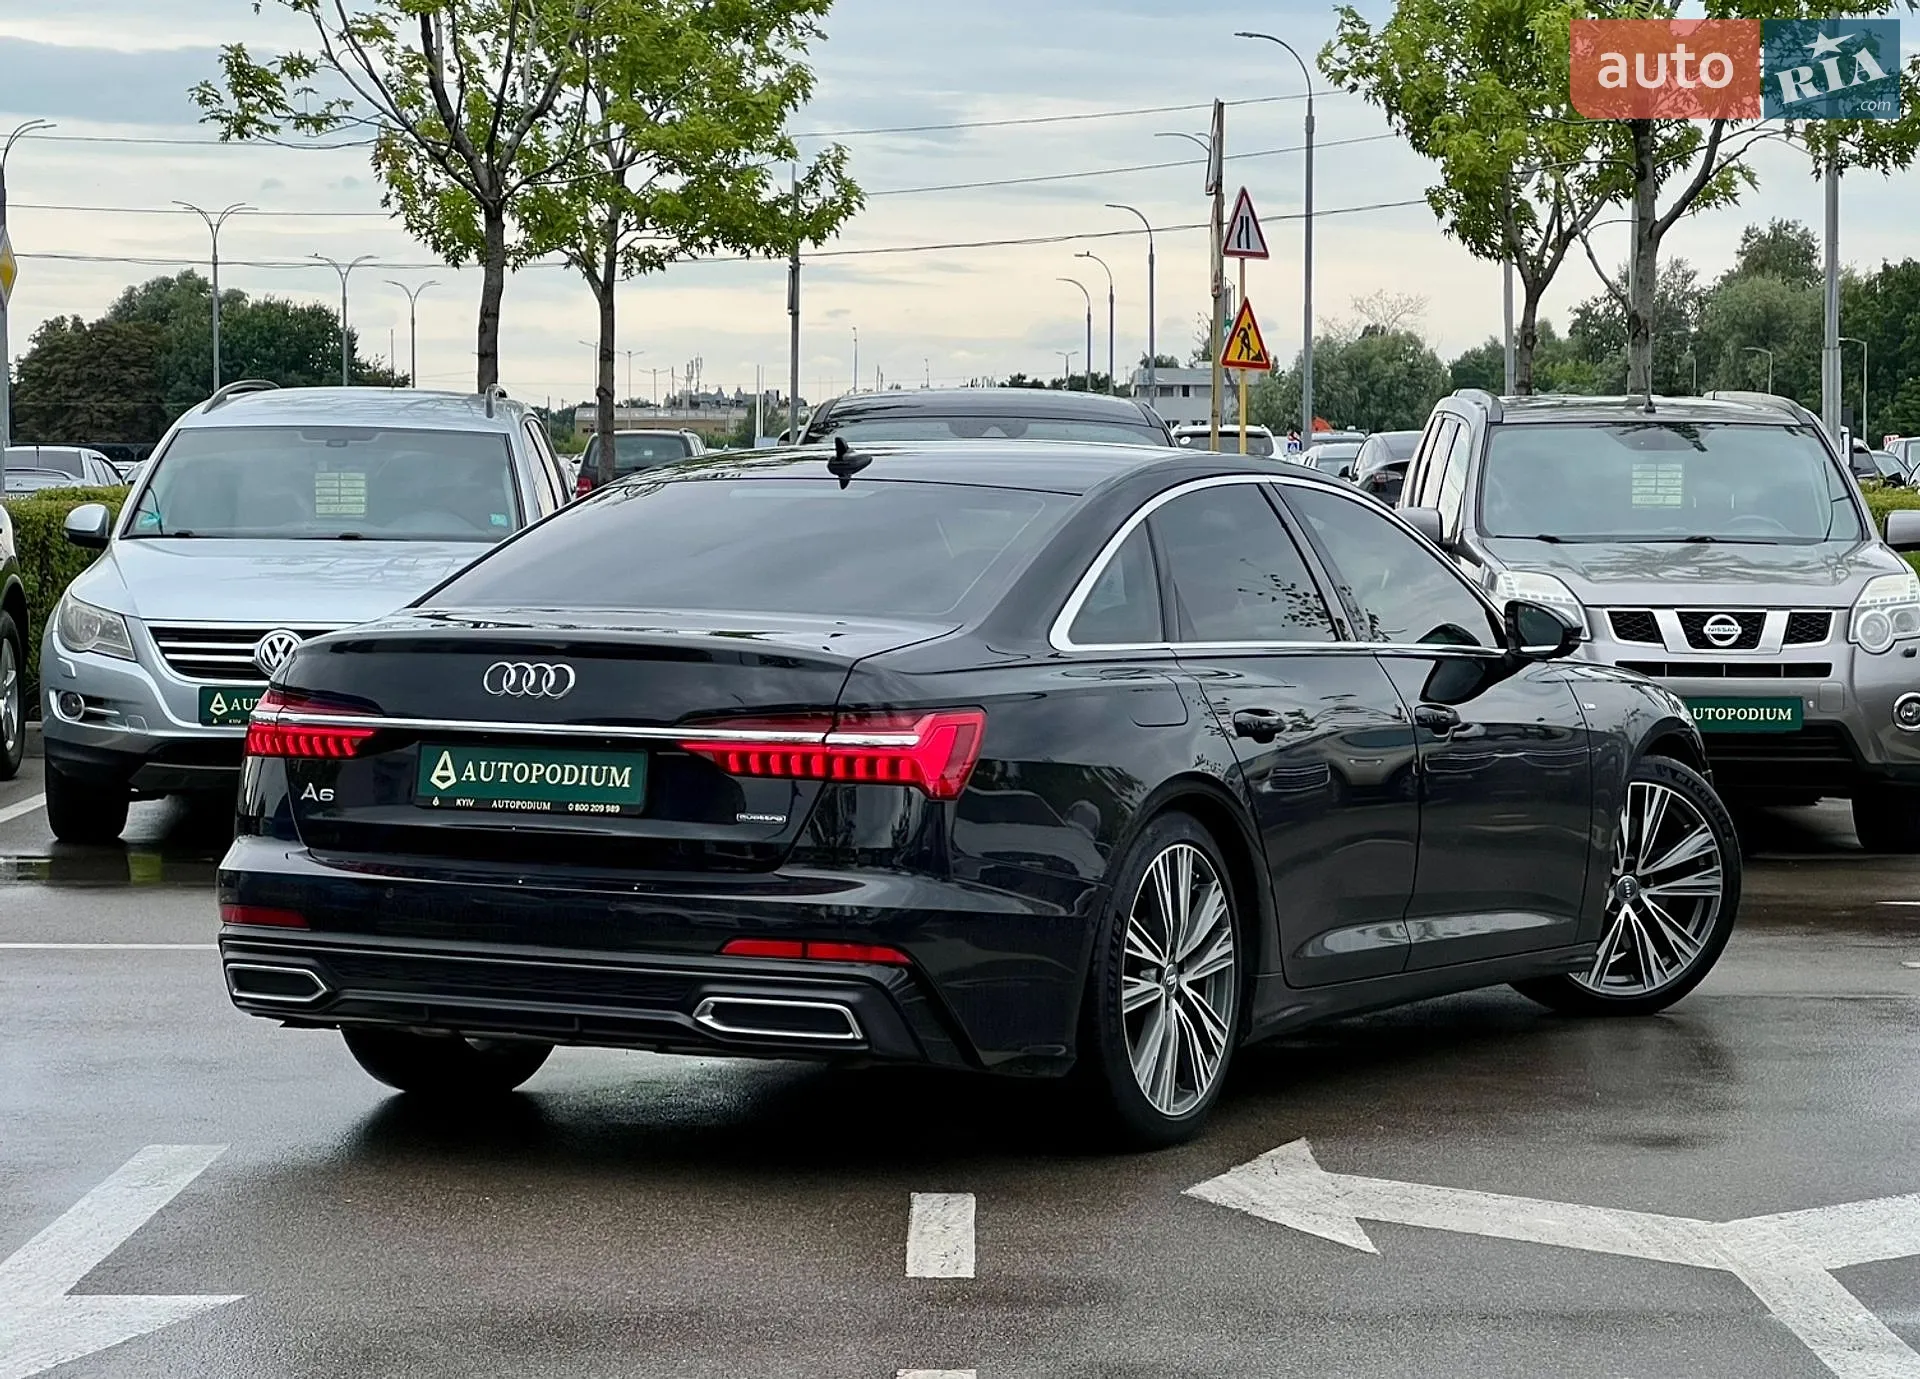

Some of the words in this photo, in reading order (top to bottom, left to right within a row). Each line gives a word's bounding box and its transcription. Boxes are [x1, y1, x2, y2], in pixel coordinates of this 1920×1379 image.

[460, 760, 632, 788] AUTOPODIUM
[300, 782, 335, 802] A6
[455, 798, 475, 807] KYIV
[491, 799, 551, 811] AUTOPODIUM
[567, 802, 574, 812] 0
[575, 803, 590, 812] 800
